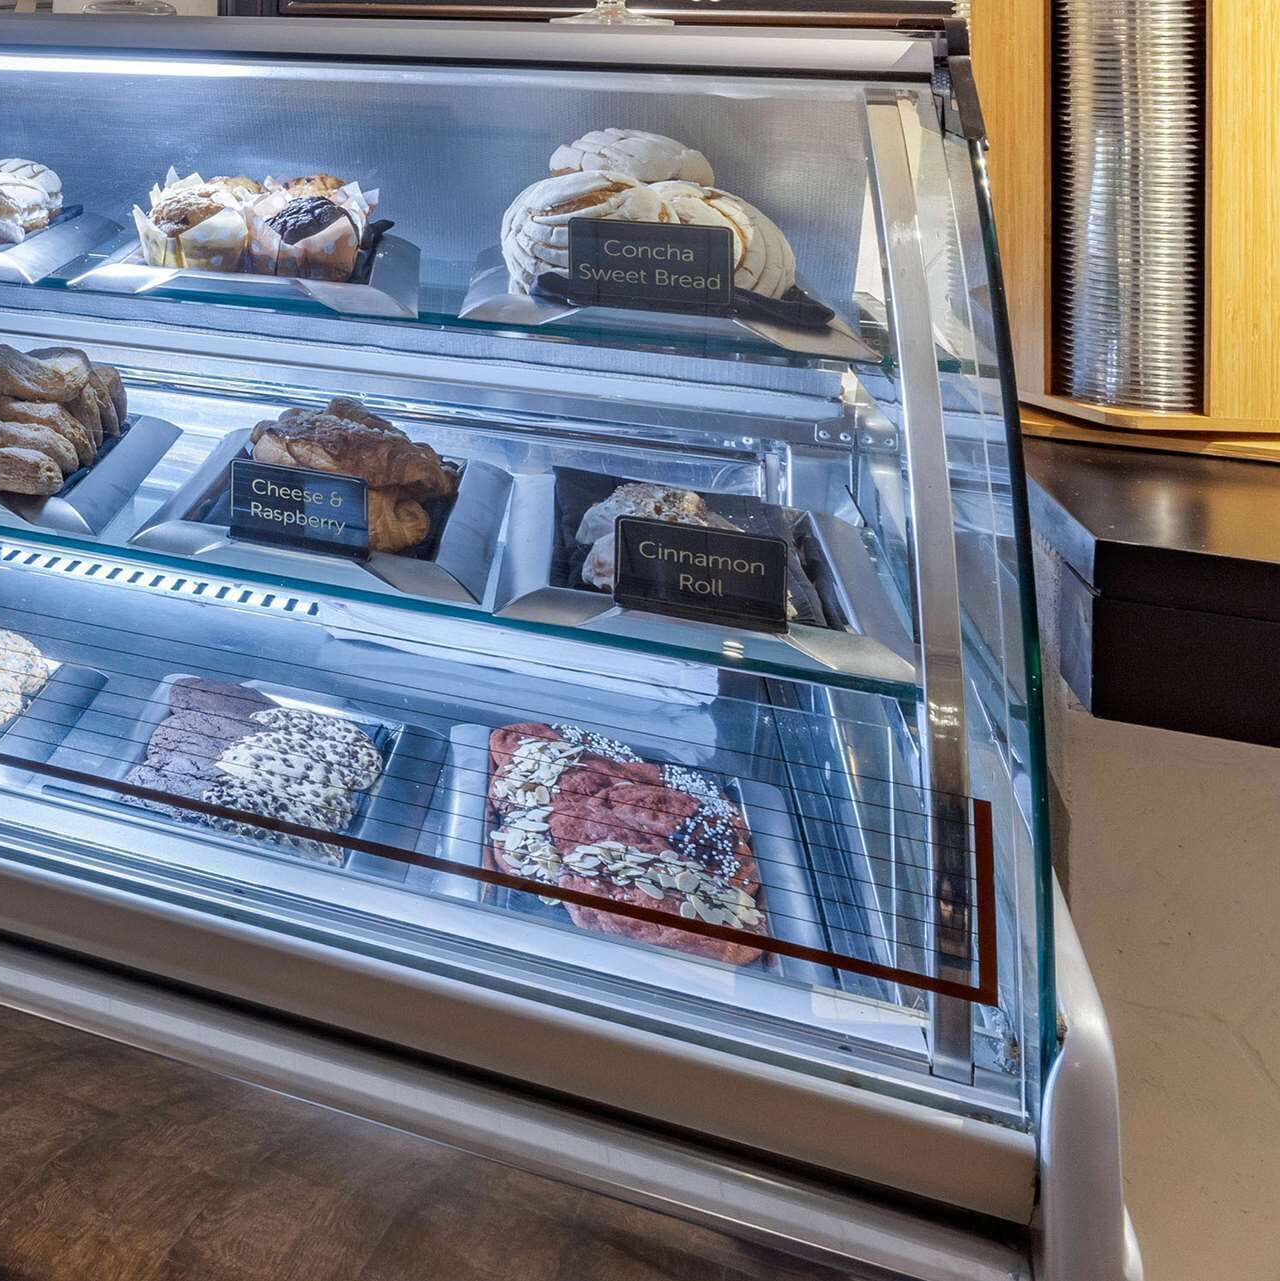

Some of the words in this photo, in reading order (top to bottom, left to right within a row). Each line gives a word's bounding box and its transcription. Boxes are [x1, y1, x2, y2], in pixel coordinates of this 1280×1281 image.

[604, 239, 694, 262] Concha
[579, 263, 648, 285] Sweet
[655, 270, 721, 290] Bread
[251, 479, 323, 505] Cheese
[330, 491, 344, 508] &
[250, 501, 346, 535] Raspberry
[639, 541, 765, 576] Cinnamon
[679, 574, 724, 597] Roll
